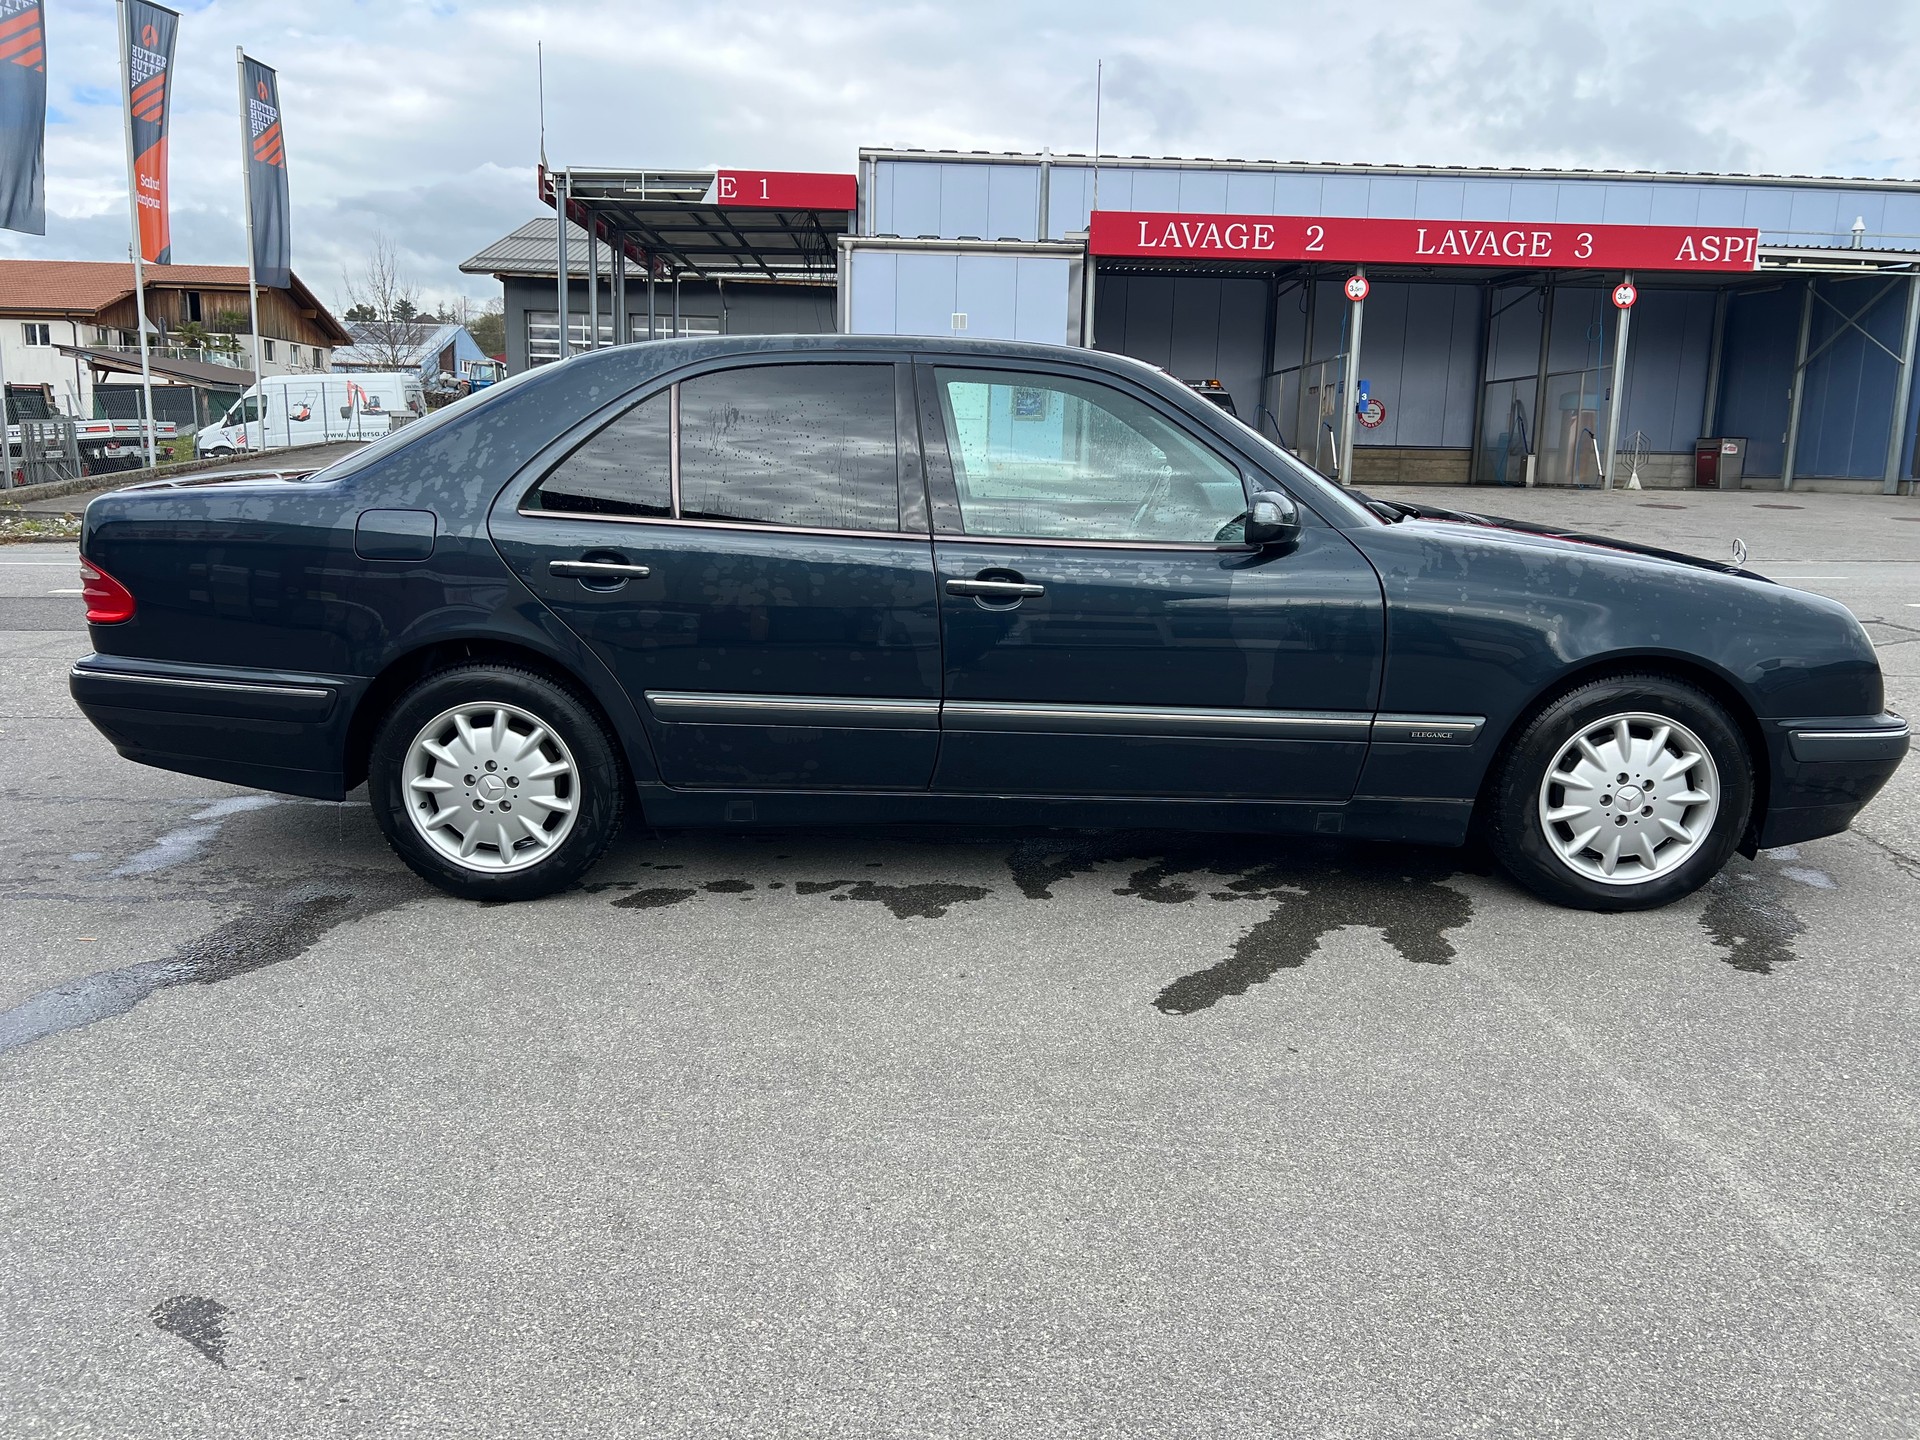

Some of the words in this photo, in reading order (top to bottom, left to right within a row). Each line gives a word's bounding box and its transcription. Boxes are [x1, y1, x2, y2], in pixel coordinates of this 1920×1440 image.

[131, 44, 167, 68] HUTTER
[250, 98, 278, 118] HUTTER
[140, 173, 161, 191] Salut
[719, 176, 738, 199] E
[759, 178, 770, 200] 1
[1137, 220, 1275, 251] LAVAGE
[1305, 225, 1325, 252] 2
[1415, 228, 1552, 258] LAVAGE
[1574, 232, 1593, 259] 3
[1674, 235, 1756, 263] ASPI
[1361, 392, 1368, 401] 3
[1411, 731, 1454, 739] ELEGANCE
